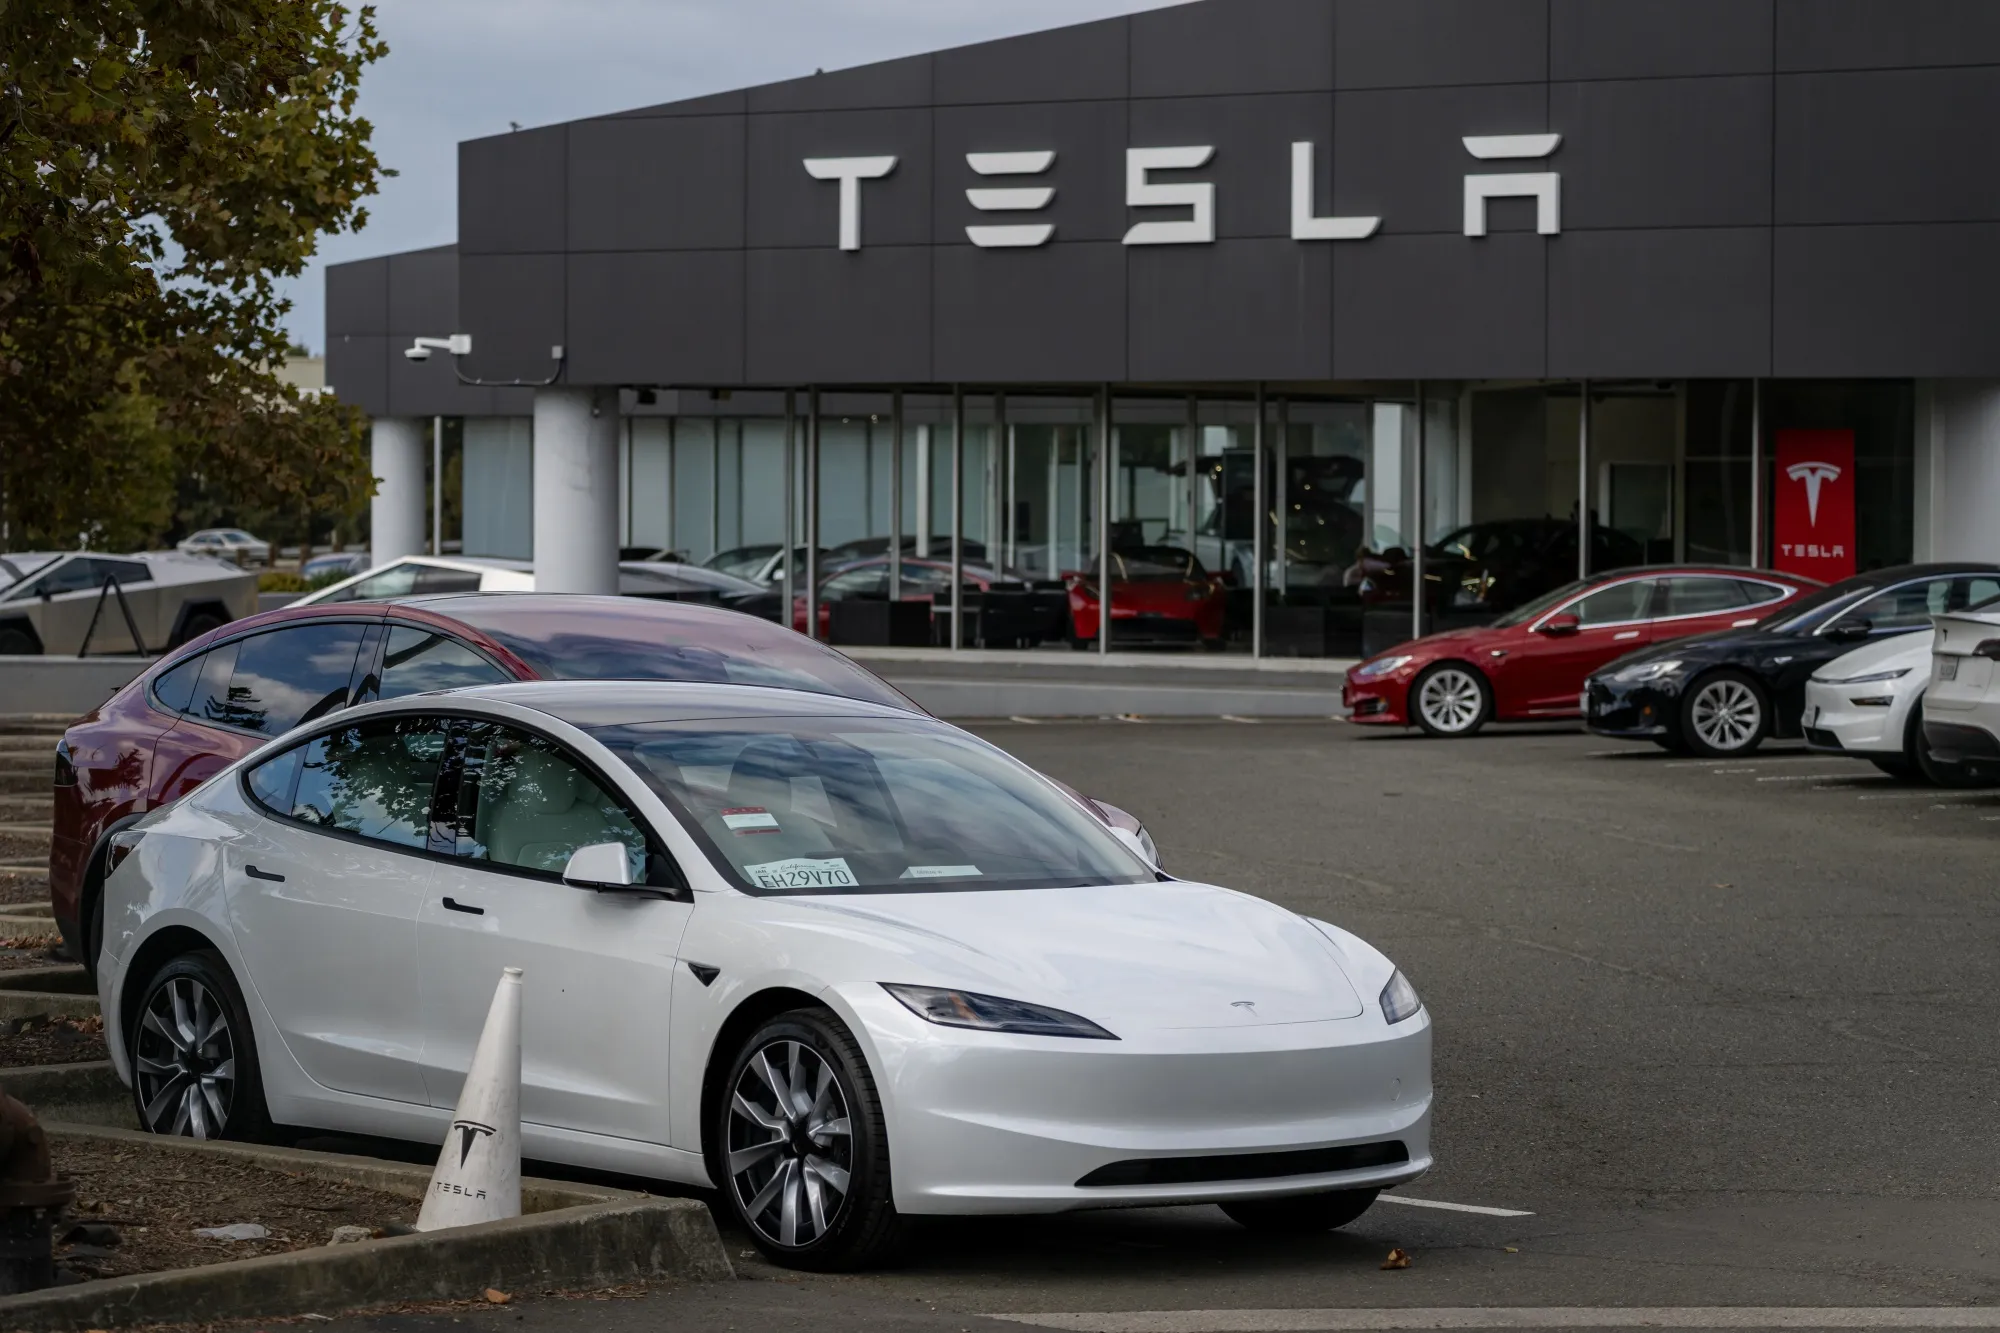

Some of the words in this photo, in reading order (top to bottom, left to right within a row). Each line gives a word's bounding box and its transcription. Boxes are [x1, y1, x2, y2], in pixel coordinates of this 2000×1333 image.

[803, 133, 1562, 251] TESLA
[1781, 544, 1844, 558] TESLA
[758, 870, 850, 888] EH29V70
[436, 1181, 487, 1200] TESLA
